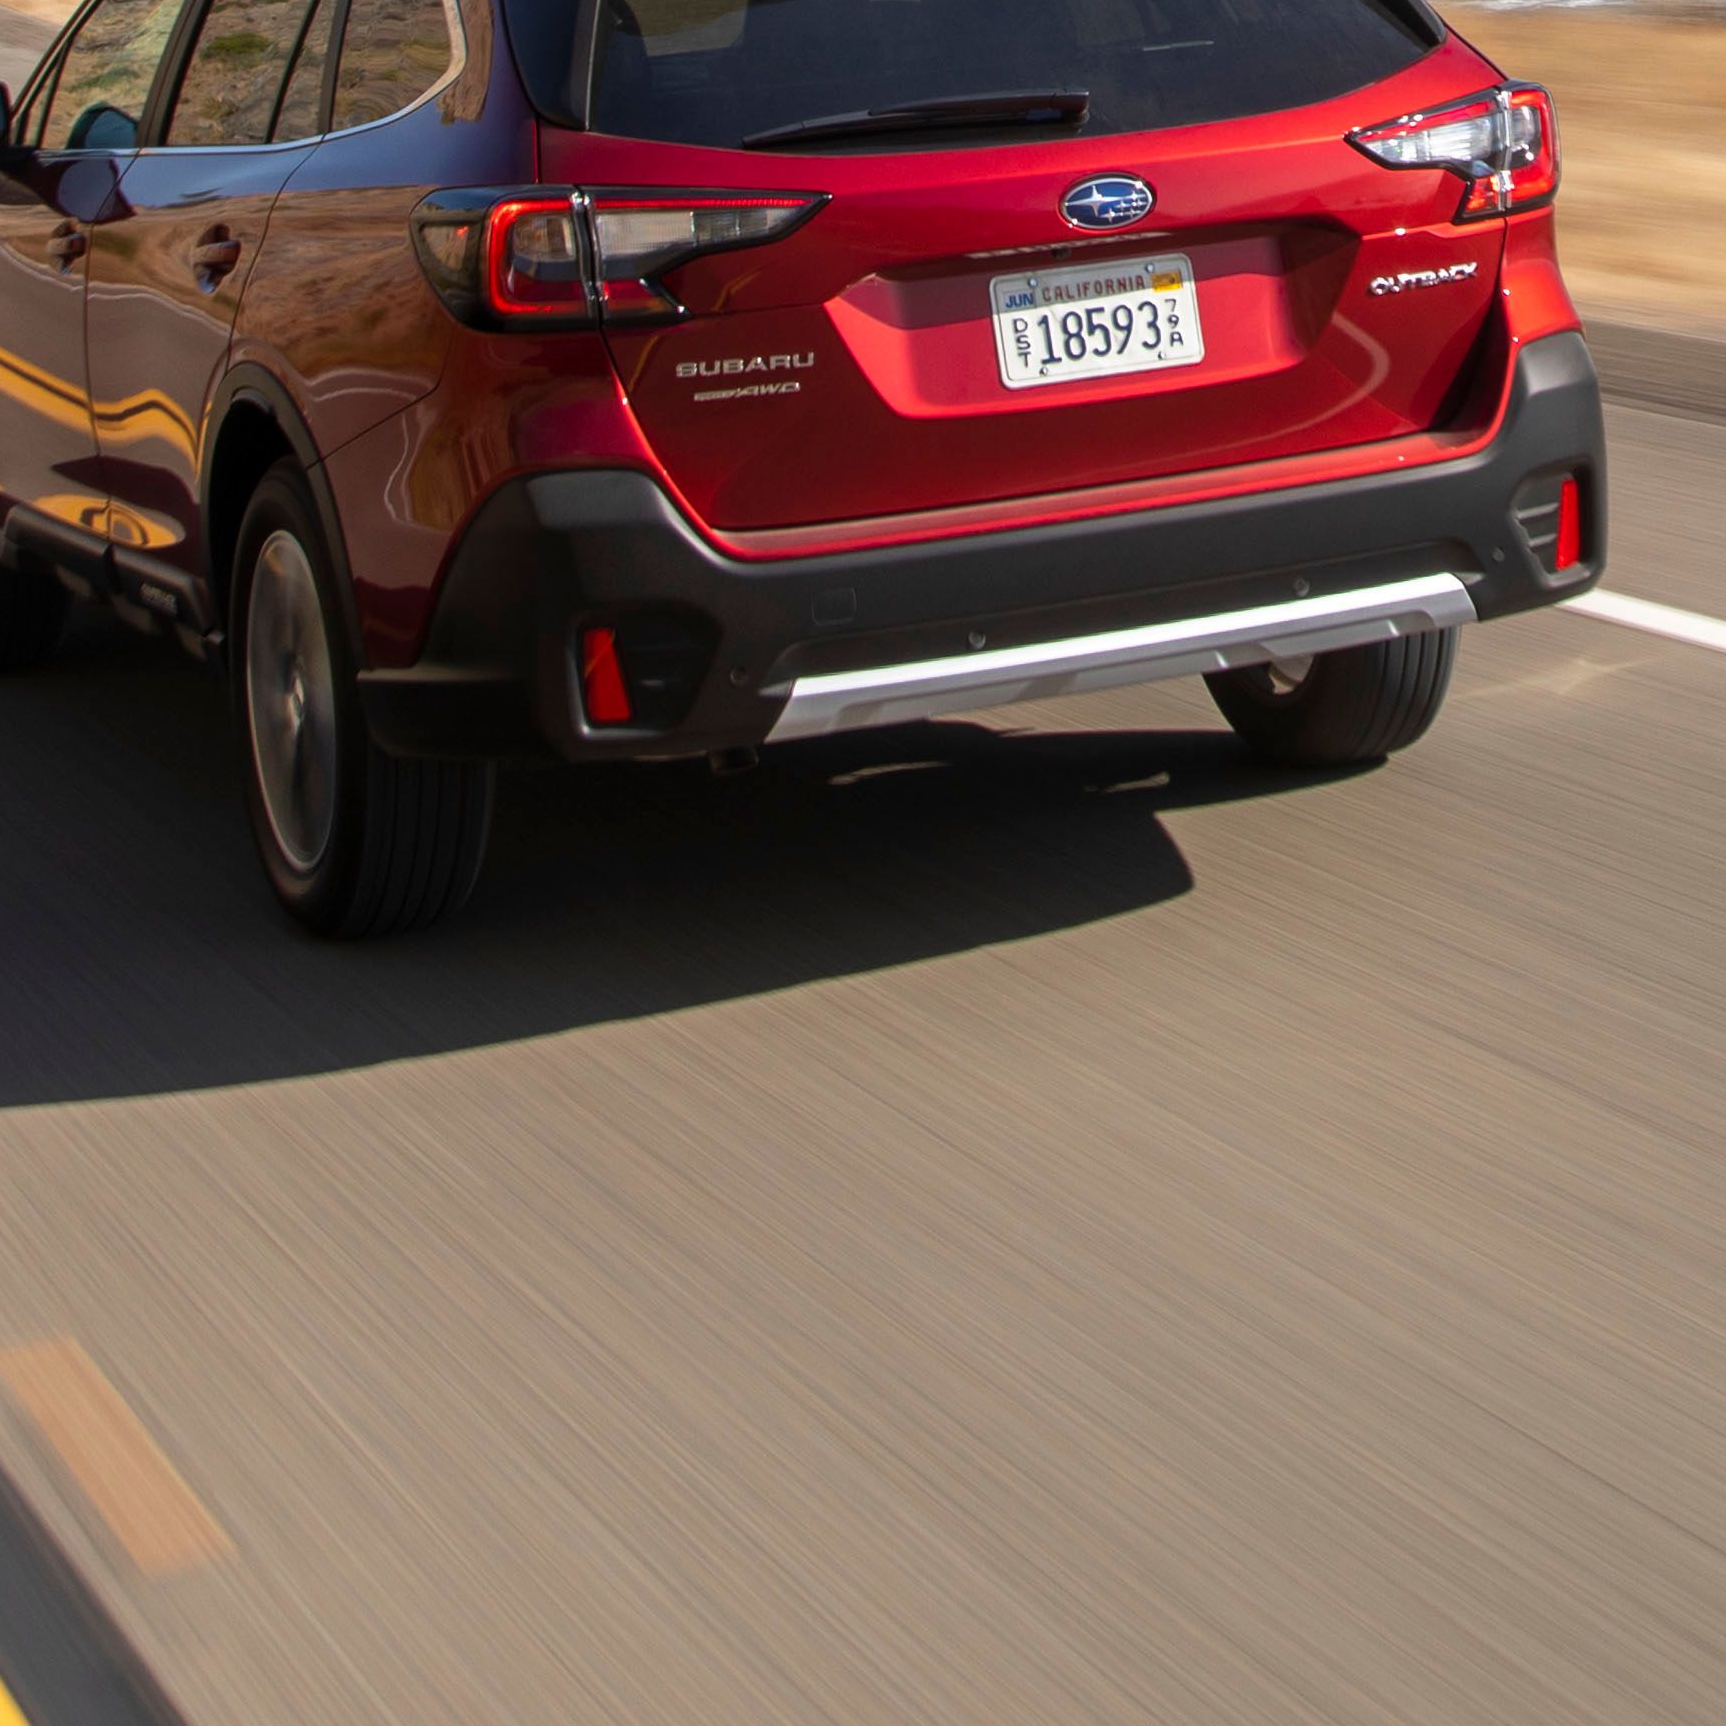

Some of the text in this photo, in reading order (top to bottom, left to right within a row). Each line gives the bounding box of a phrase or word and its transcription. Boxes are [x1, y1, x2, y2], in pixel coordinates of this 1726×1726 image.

[1005, 293, 1034, 308] JUN
[1042, 275, 1145, 302] CALIFORNIA
[1038, 300, 1162, 364] 18593
[676, 352, 815, 377] SUBARU
